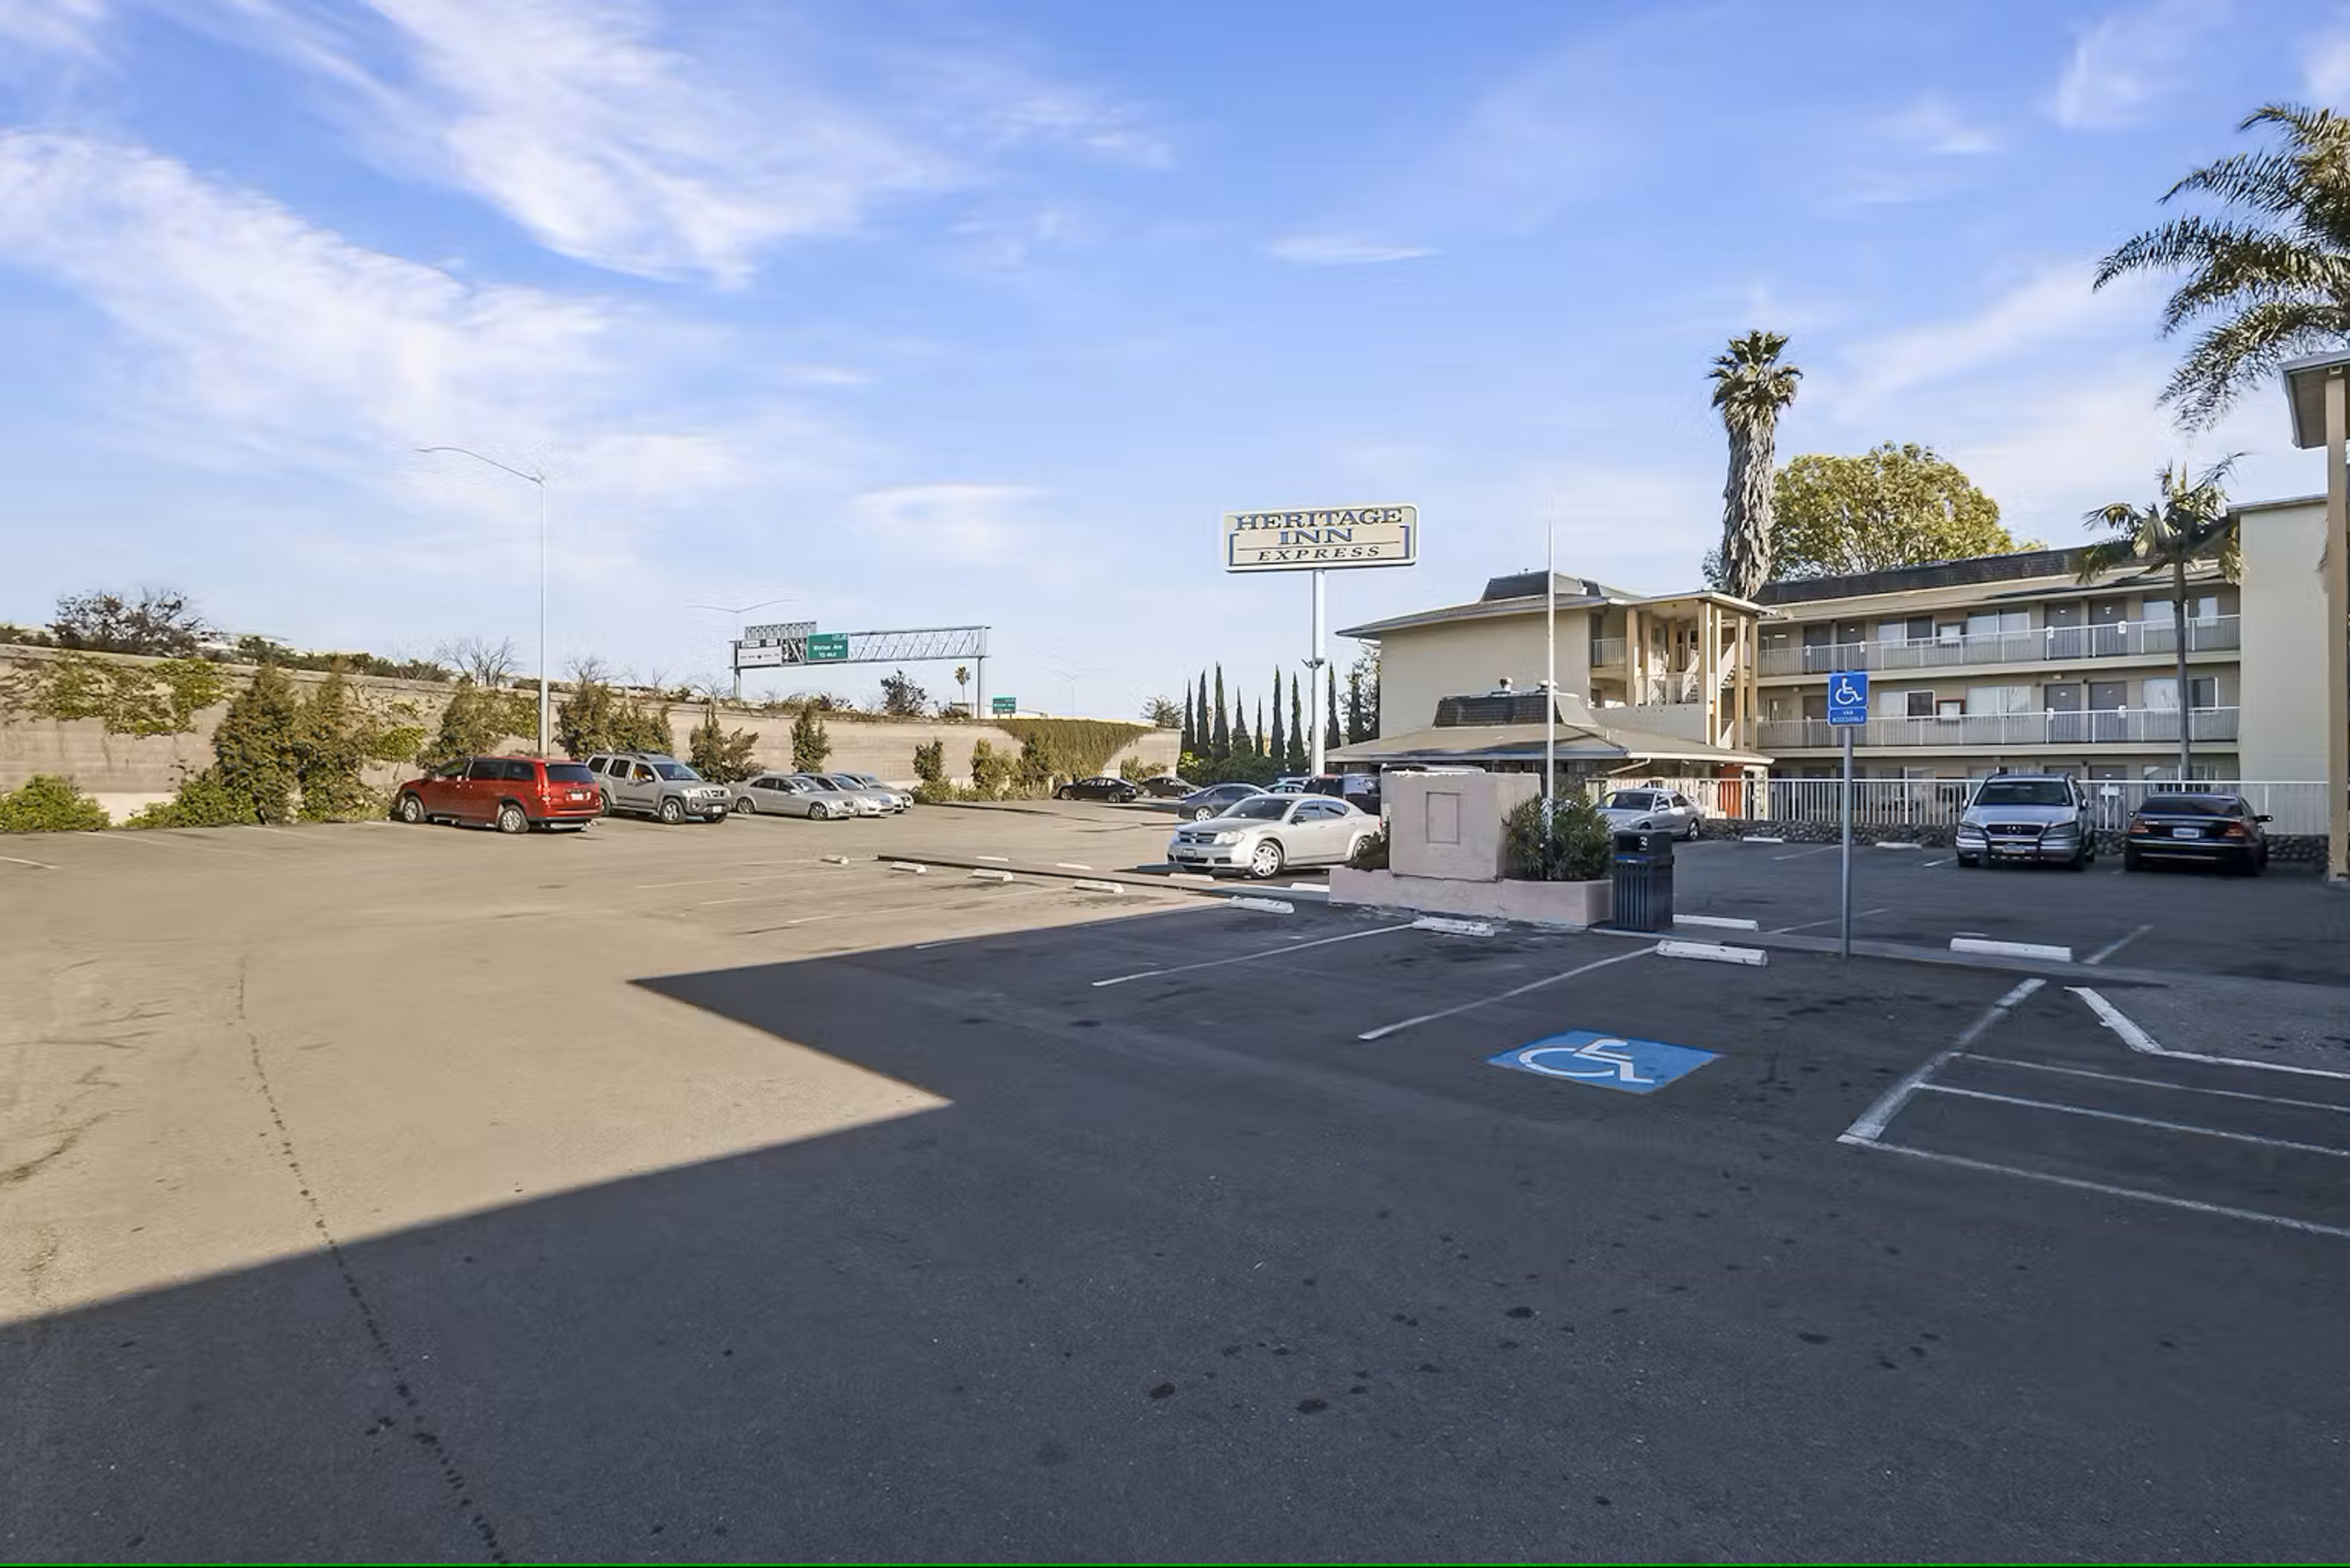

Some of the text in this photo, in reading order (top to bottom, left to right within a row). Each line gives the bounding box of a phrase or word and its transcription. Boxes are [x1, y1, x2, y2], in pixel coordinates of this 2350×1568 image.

[1234, 508, 1402, 531] HERITAGE
[1278, 528, 1353, 545] INN
[1257, 546, 1380, 561] EXPRESS
